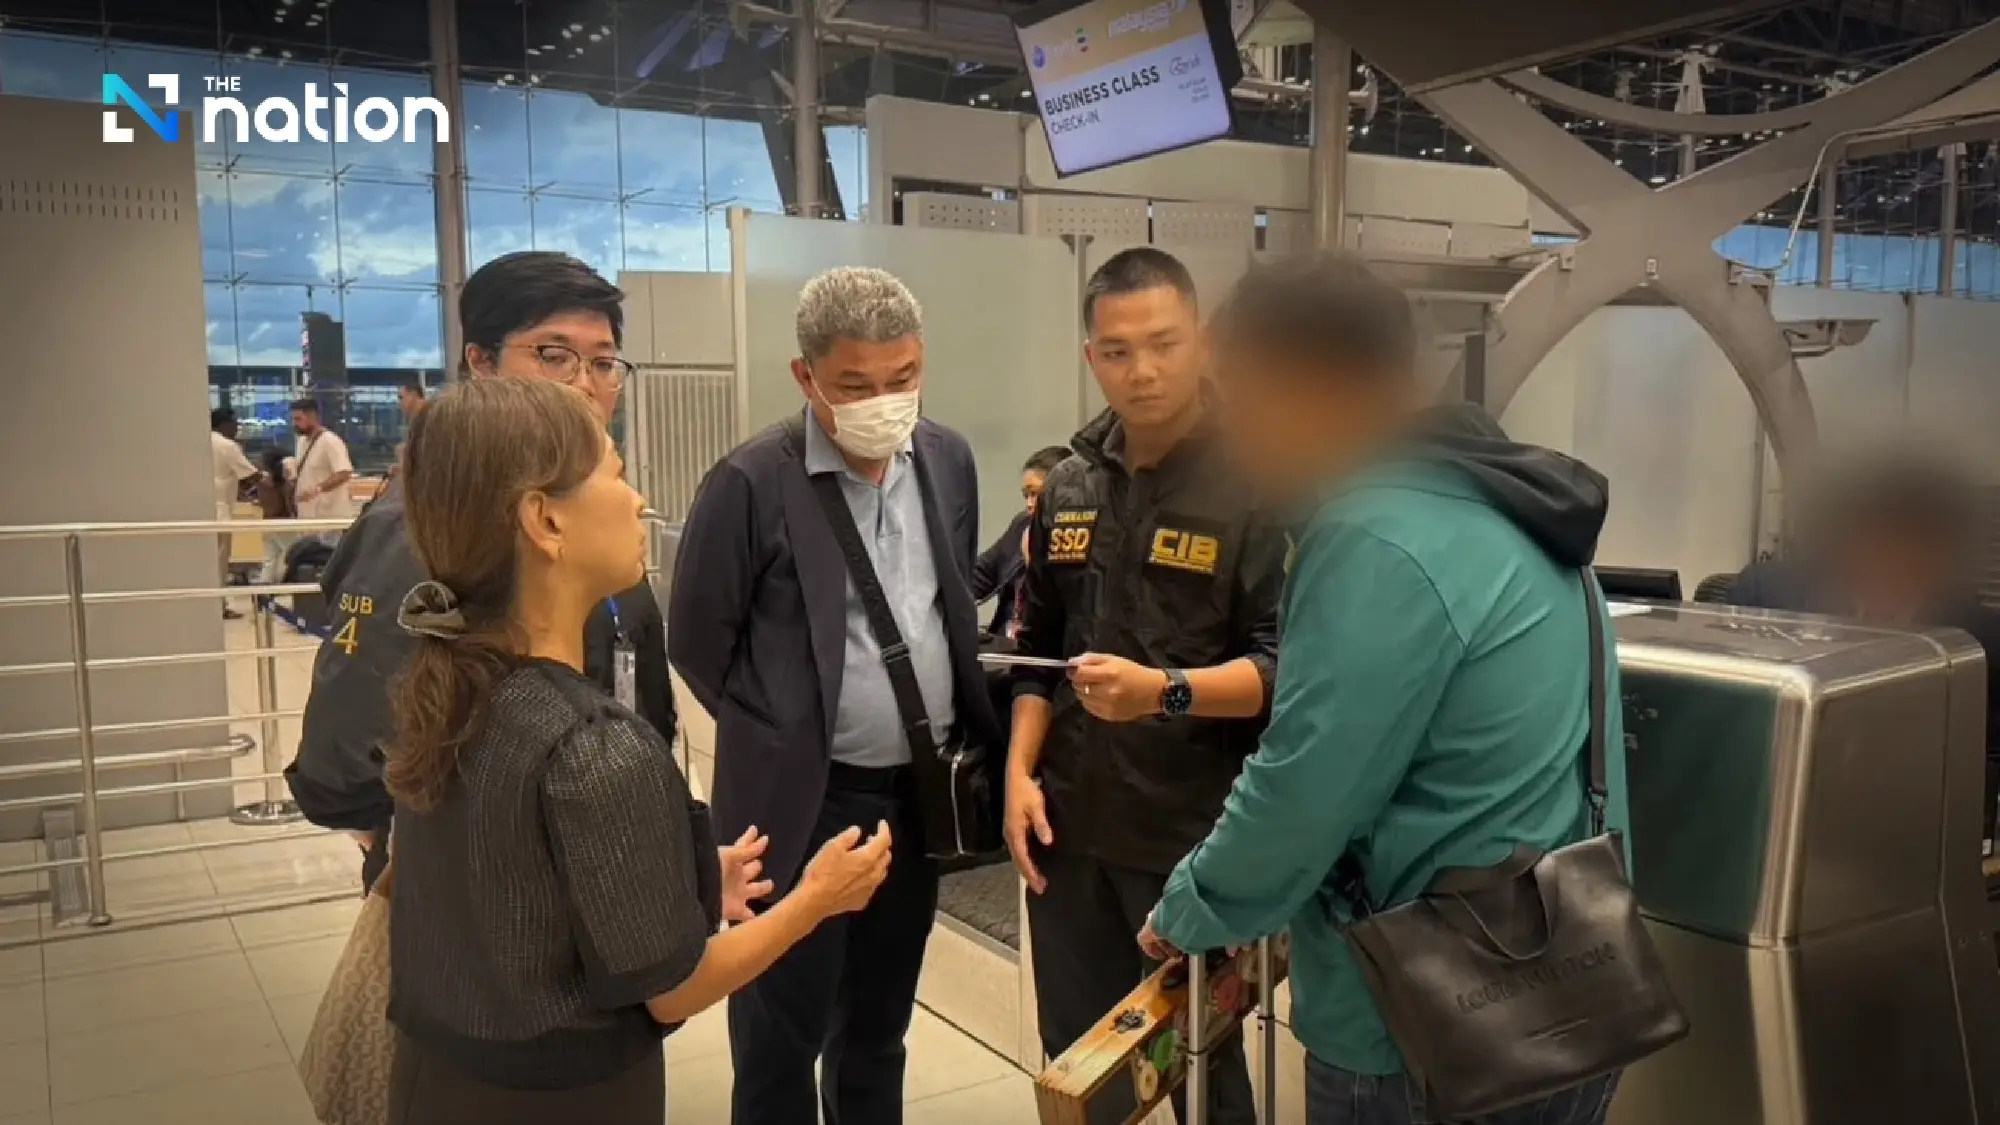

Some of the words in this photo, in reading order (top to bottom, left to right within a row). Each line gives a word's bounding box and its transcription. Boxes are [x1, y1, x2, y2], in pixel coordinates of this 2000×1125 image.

[1044, 81, 1110, 116] BUSINESS
[1111, 65, 1161, 96] CLASS
[1051, 108, 1101, 135] CHECK-IN
[1050, 527, 1090, 552] SSD
[1152, 528, 1219, 563] CIB
[338, 593, 373, 614] SUB
[331, 616, 359, 655] 4
